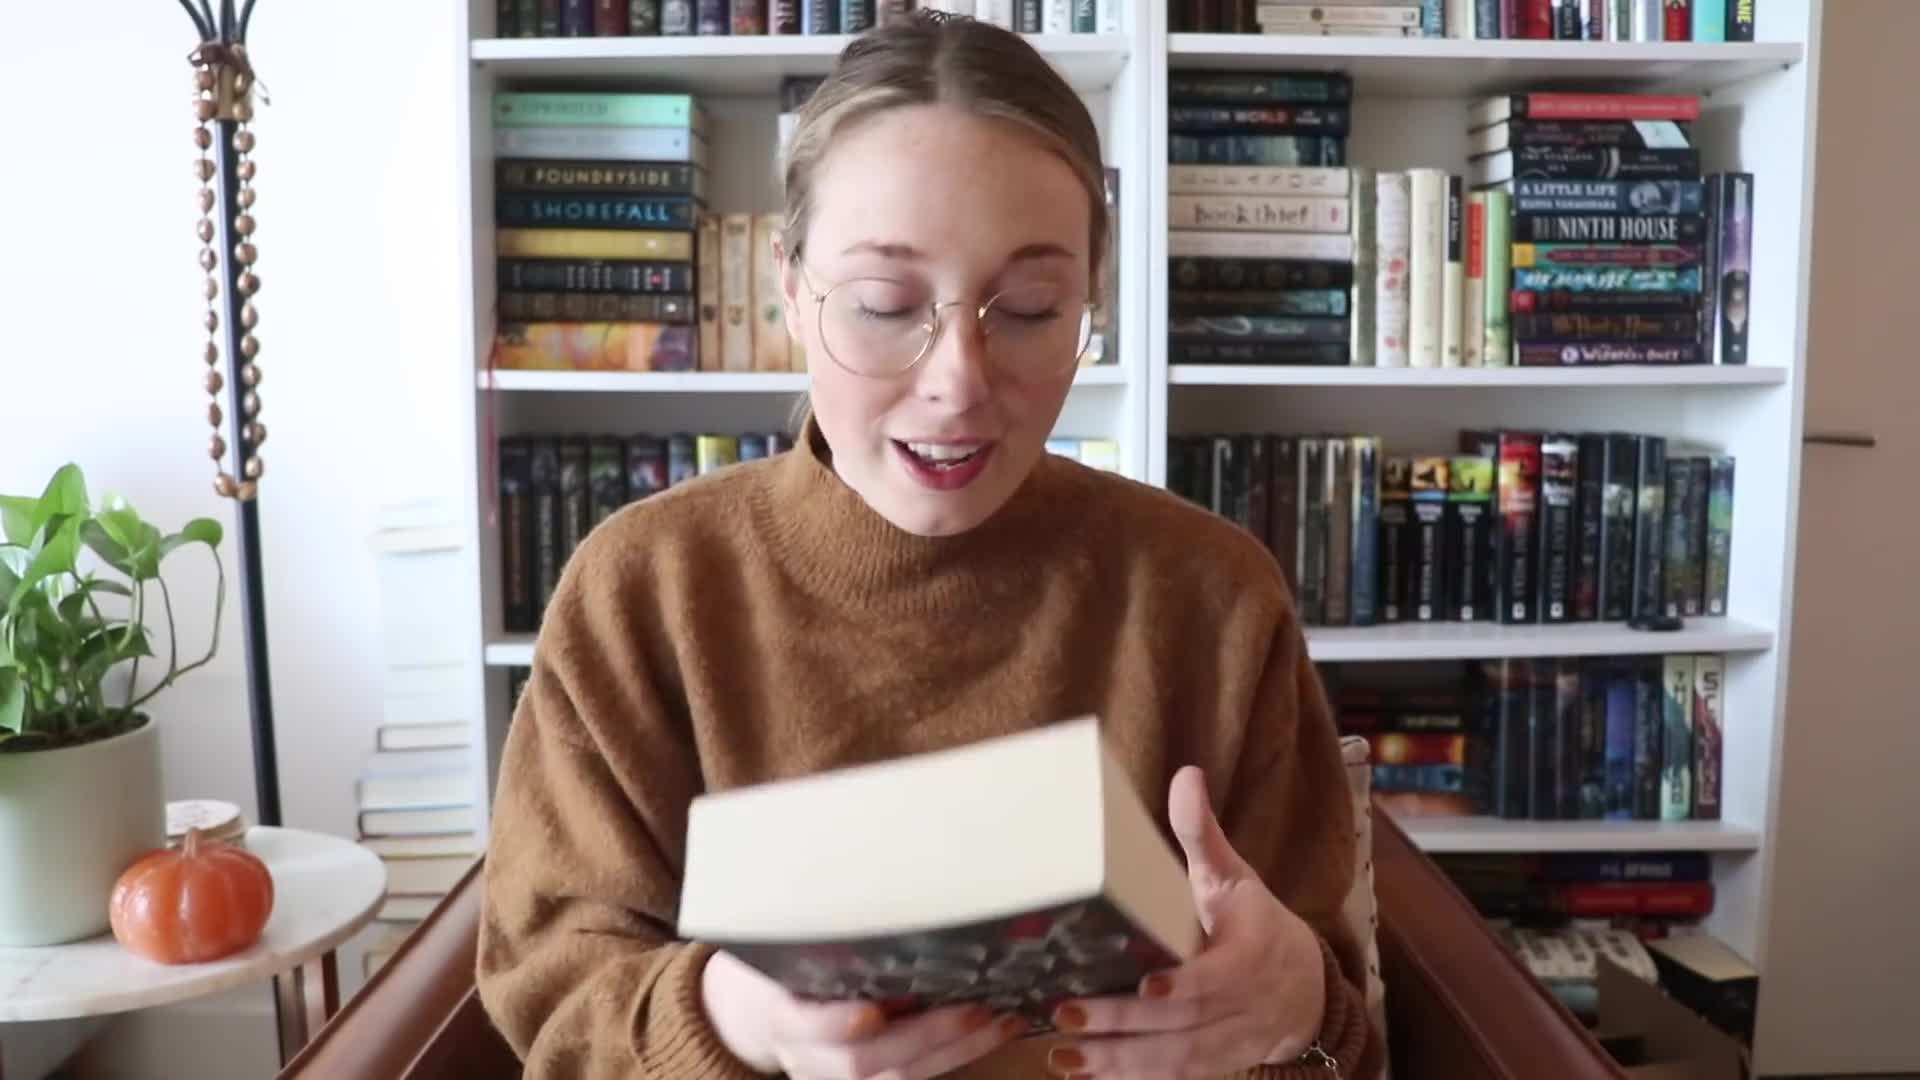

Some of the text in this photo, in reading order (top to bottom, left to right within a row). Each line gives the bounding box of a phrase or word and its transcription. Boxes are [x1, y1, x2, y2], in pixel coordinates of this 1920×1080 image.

[535, 167, 671, 187] FOUNDRYSIDE
[1519, 183, 1617, 196] A LITTLE LIFE
[532, 203, 671, 222] SHOREFALL
[1558, 216, 1616, 241] NINTH
[1619, 216, 1680, 241] HOUSE
